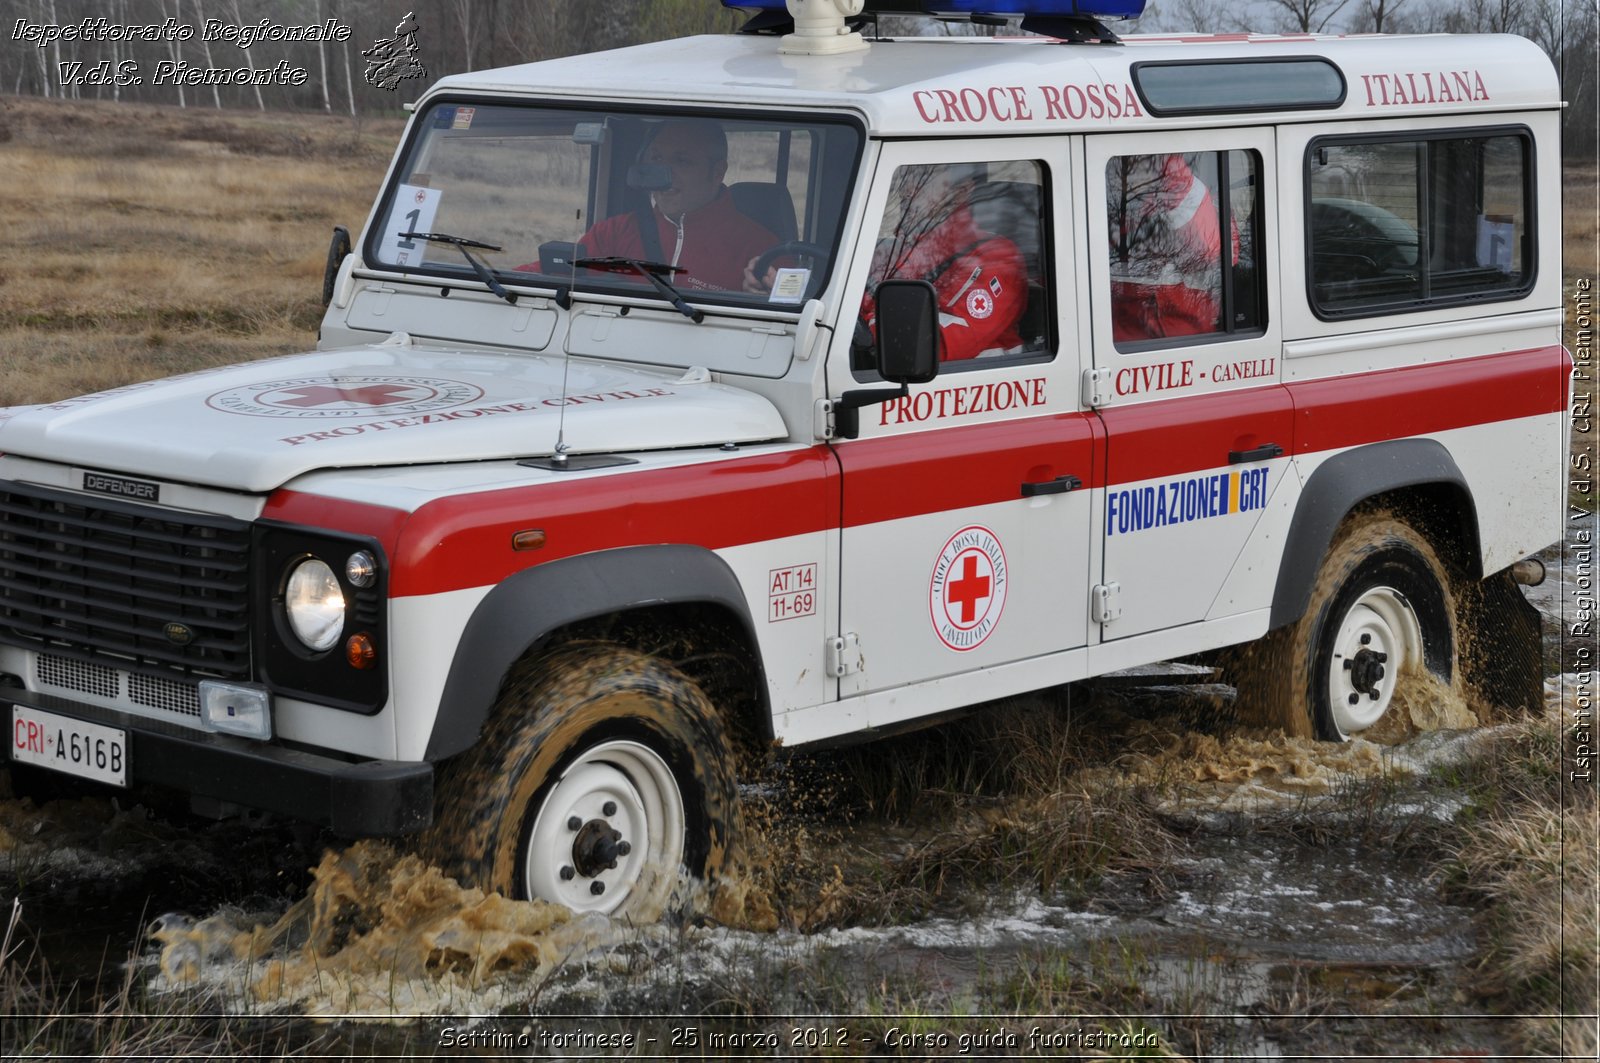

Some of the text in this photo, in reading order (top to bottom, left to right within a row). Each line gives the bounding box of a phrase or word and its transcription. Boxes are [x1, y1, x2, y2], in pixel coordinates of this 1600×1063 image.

[912, 69, 1491, 125] CROCE ROSSA ITALIANA
[397, 208, 421, 250] 1
[280, 386, 676, 446] PROTEZIONE CIVILE
[878, 377, 1048, 428] PROTEZIONE
[1115, 360, 1194, 398] CIVILE
[1210, 357, 1276, 385] CANELLI
[86, 475, 156, 499] DEFENDER
[1107, 466, 1270, 536] FONDAZIONE CRT
[772, 567, 813, 593] AT 14
[933, 532, 1005, 593] CROCE ROSSA ITALIANA
[773, 593, 813, 618] 11-69
[942, 618, 992, 647] CANELLI (AT)
[15, 718, 123, 774] CRI A616B
